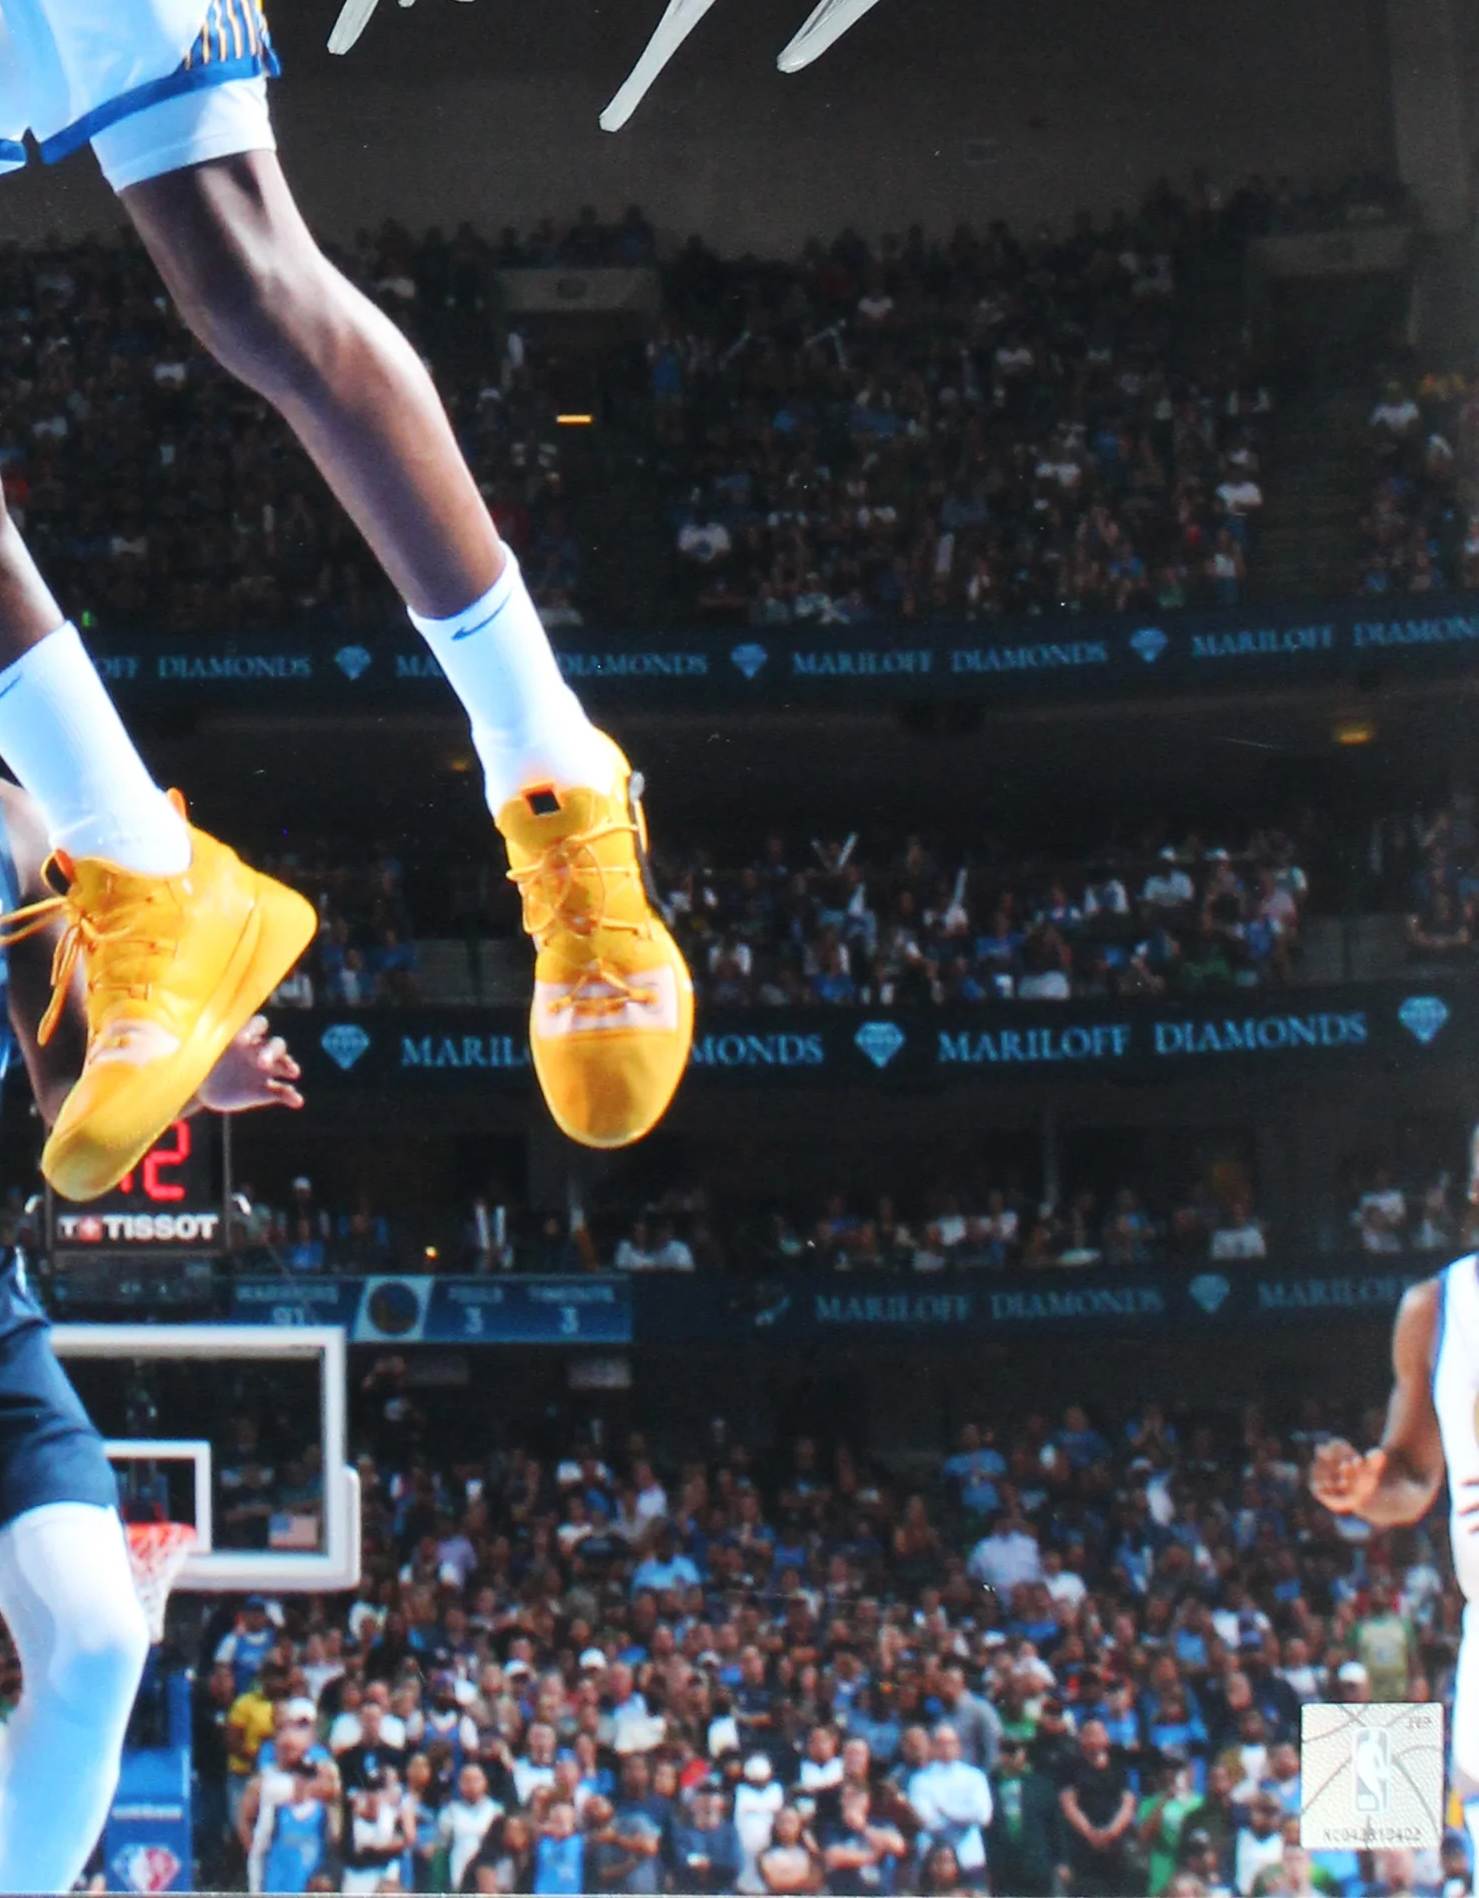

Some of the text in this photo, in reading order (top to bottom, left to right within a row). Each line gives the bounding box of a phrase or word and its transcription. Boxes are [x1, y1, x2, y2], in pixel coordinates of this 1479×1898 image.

[937, 1012, 1368, 1063] MARILOFF DIAMONDS
[102, 1212, 219, 1241] TISSOT
